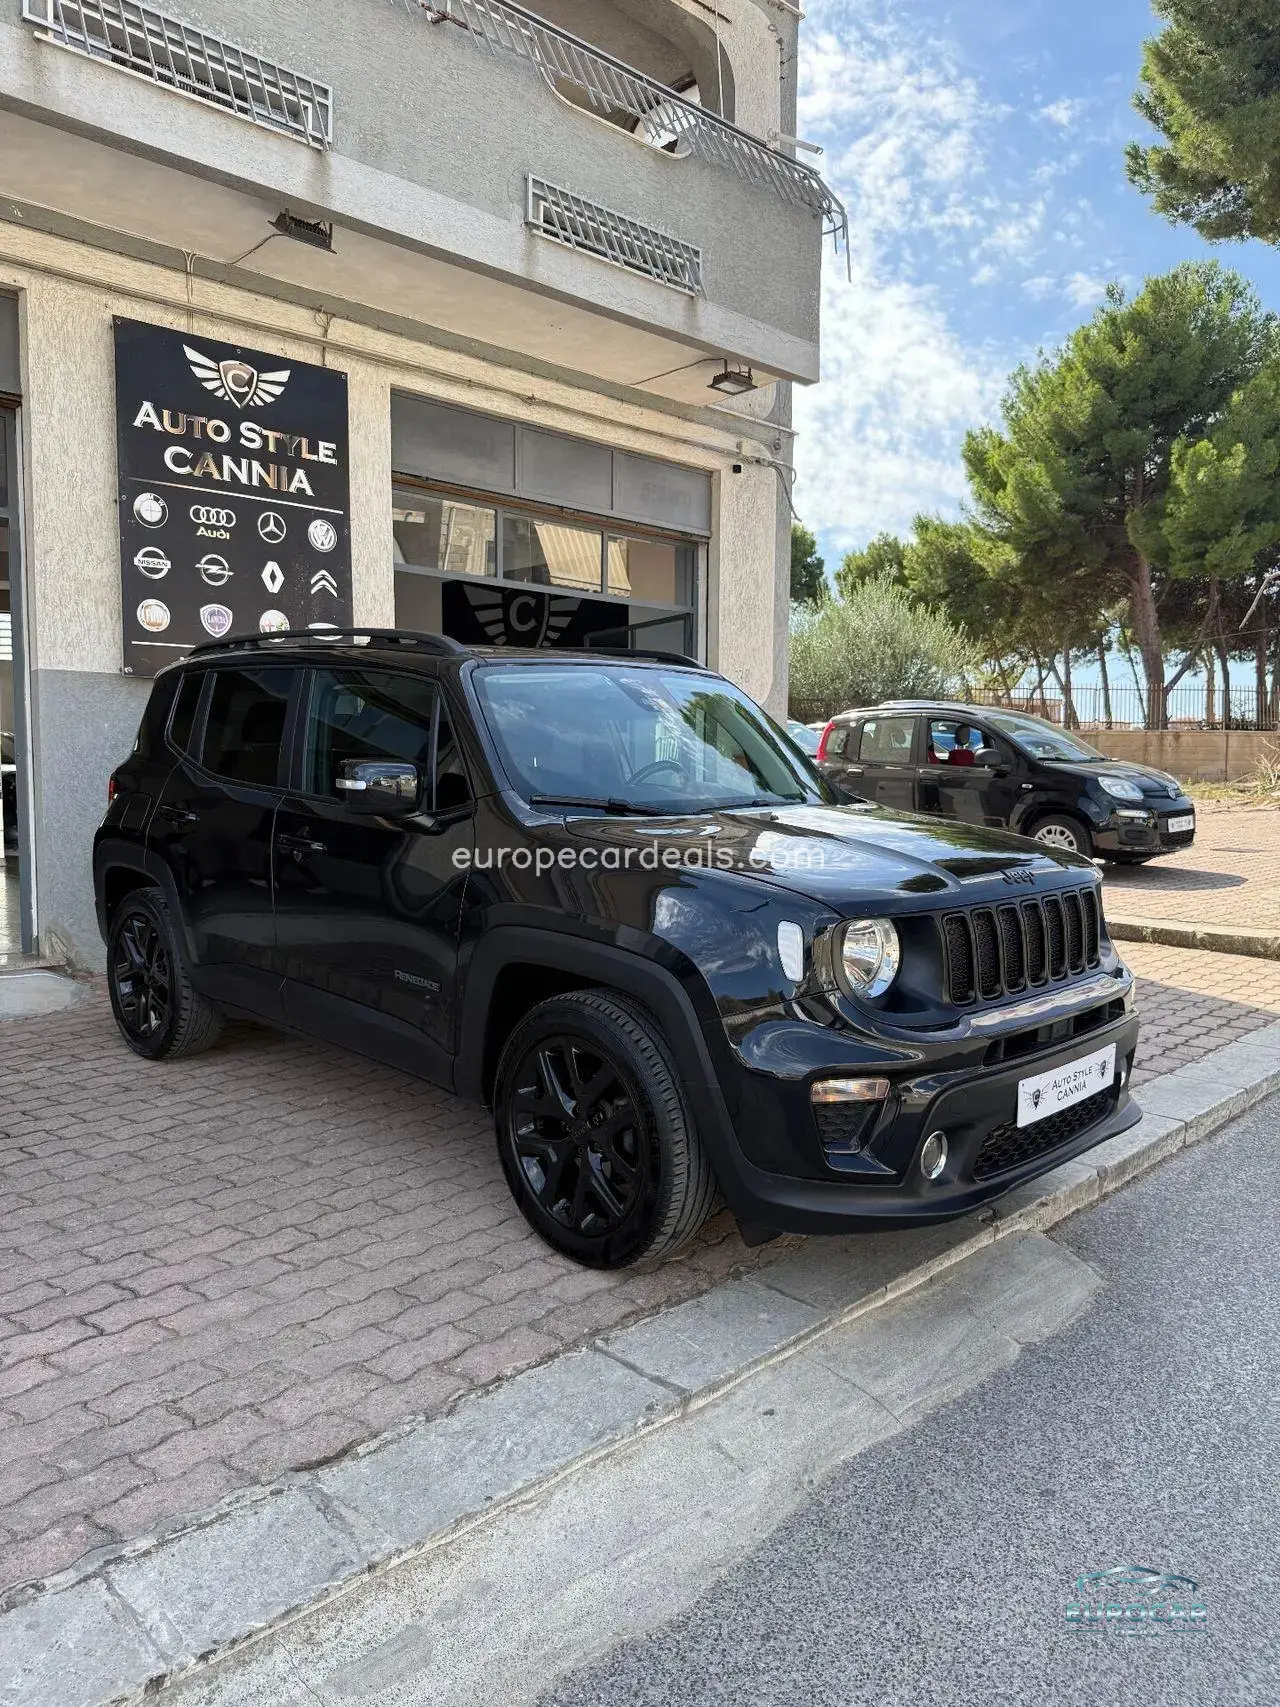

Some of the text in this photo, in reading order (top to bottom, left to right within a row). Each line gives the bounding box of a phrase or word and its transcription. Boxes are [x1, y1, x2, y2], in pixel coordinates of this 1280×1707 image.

[133, 401, 338, 465] AUTO STYLE
[163, 445, 315, 497] CANNIA
[196, 526, 230, 540] Audi
[138, 558, 168, 568] NISSAN
[1000, 870, 1036, 886] Jeep
[1051, 1066, 1093, 1090] AUTO STYLE
[1057, 1082, 1087, 1101] CANNIA
